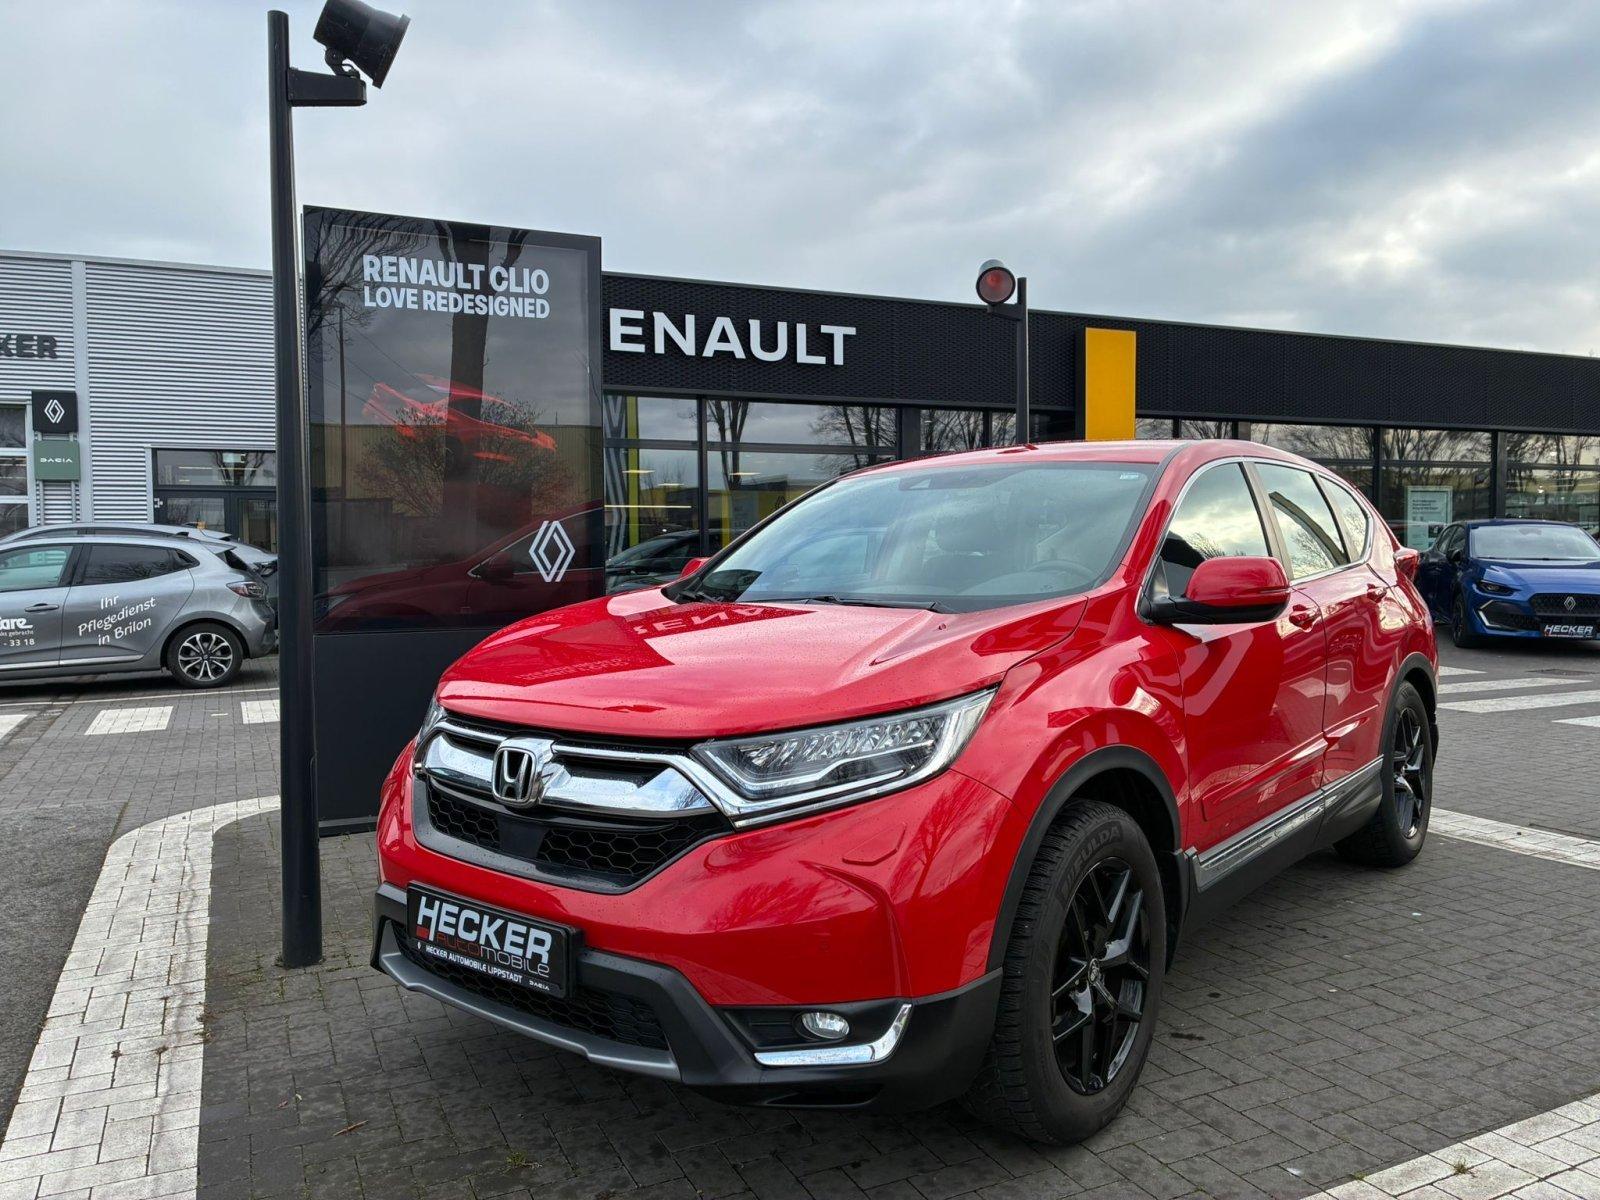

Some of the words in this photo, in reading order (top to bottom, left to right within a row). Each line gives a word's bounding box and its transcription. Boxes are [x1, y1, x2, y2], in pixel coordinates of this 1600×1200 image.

[363, 254, 486, 290] RENAULT
[489, 265, 550, 295] CLIO
[364, 285, 419, 310] LOVE
[422, 290, 550, 319] REDESIGNED
[78, 597, 156, 636] Pflegedienst
[101, 595, 119, 609] Ihr
[0, 617, 33, 630] are
[98, 634, 110, 646] in
[114, 618, 151, 640] Brilon
[1544, 624, 1593, 635] HECKER
[9, 639, 21, 647] 33
[24, 638, 35, 646] 18
[416, 896, 552, 964] HECKER
[425, 945, 447, 959] HECKER
[448, 952, 487, 973] AUTOMOBILE
[488, 963, 522, 983] LIPPSTADT
